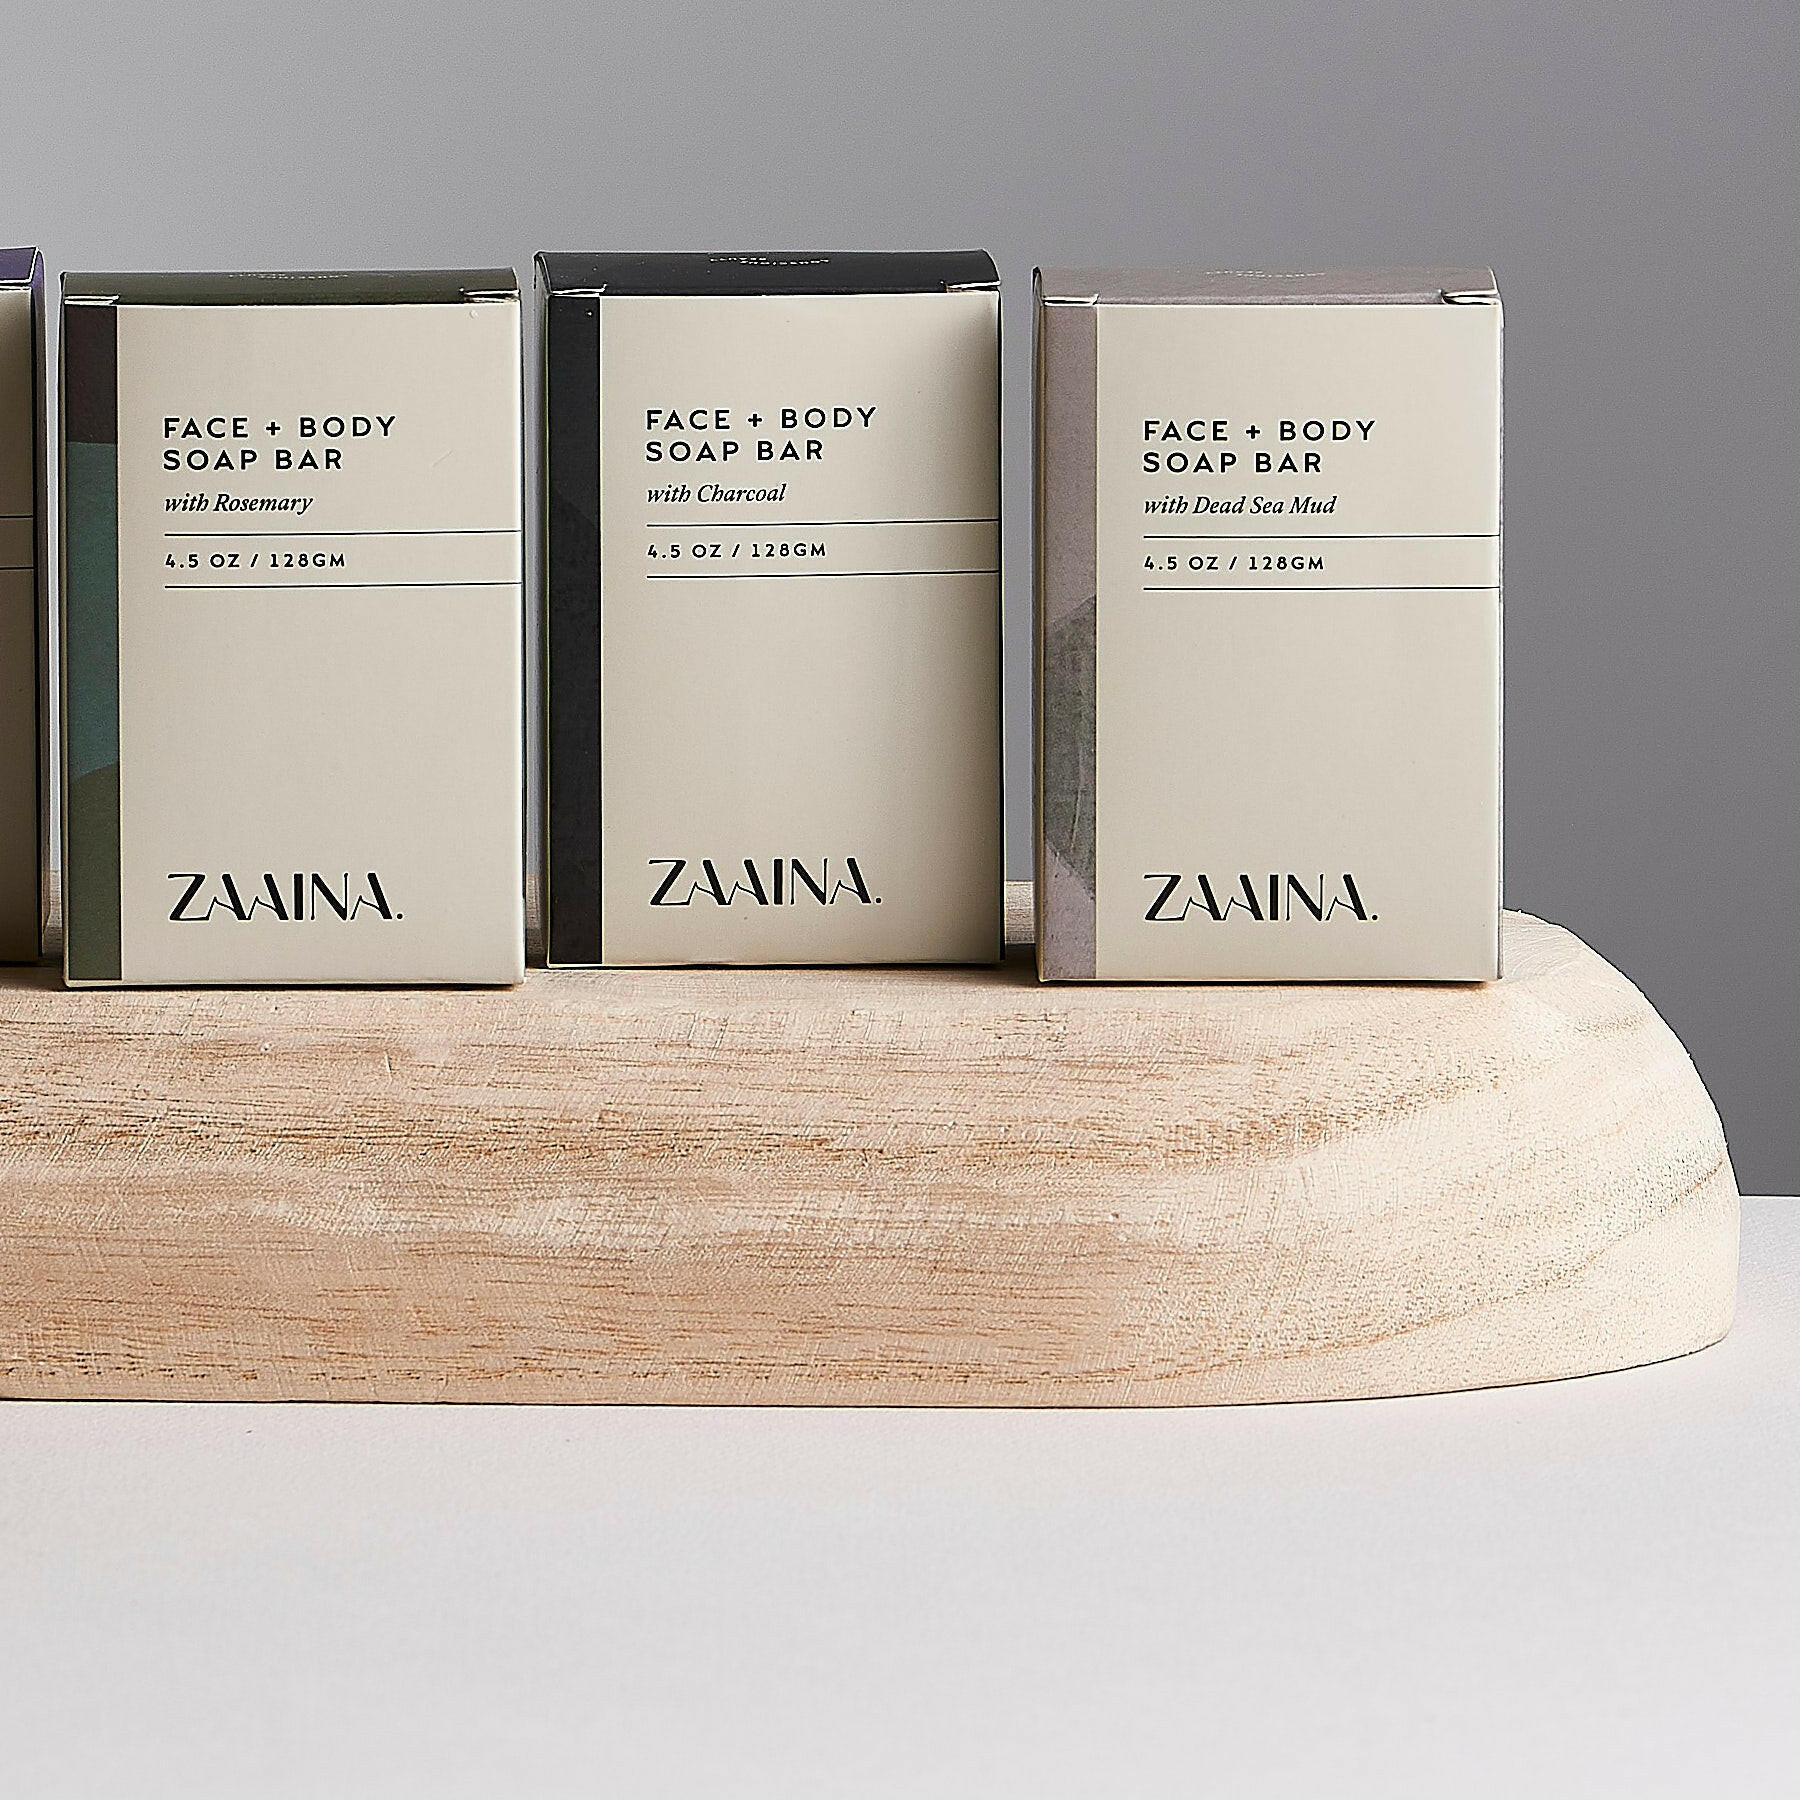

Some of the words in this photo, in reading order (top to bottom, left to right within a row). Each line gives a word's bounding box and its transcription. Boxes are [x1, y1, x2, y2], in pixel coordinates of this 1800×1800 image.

[164, 417, 249, 439] FACE
[265, 421, 281, 436] +
[299, 415, 396, 438] BODY
[646, 409, 731, 431] FACE
[747, 413, 763, 428] +
[781, 406, 877, 429] BODY
[1144, 420, 1228, 442] FACE
[1245, 424, 1261, 440] +
[1279, 420, 1376, 442] BODY
[163, 449, 258, 471] SOAP
[275, 448, 342, 470] BAR
[645, 440, 740, 462] SOAP
[757, 439, 823, 461] BAR
[1143, 451, 1237, 474] SOAP
[1255, 452, 1321, 473] BAR
[647, 483, 692, 503] with
[697, 482, 787, 503] Charcoal
[165, 492, 210, 512] with
[212, 493, 314, 516] Rosemary
[1144, 495, 1189, 514] with
[1191, 495, 1247, 515] Dead
[1249, 496, 1285, 515] Sea
[1288, 495, 1338, 514] Mud
[165, 553, 199, 569] 4.5
[209, 553, 240, 569] OZ
[250, 553, 259, 568] /
[270, 552, 345, 568] 128GM
[647, 544, 681, 559] 4.5
[691, 543, 722, 559] OZ
[731, 543, 741, 558] /
[751, 542, 826, 558] 128GM
[1143, 555, 1178, 571] 4.5
[1188, 555, 1219, 571] OZ
[1228, 556, 1238, 571] /
[1248, 555, 1324, 571] 128GM
